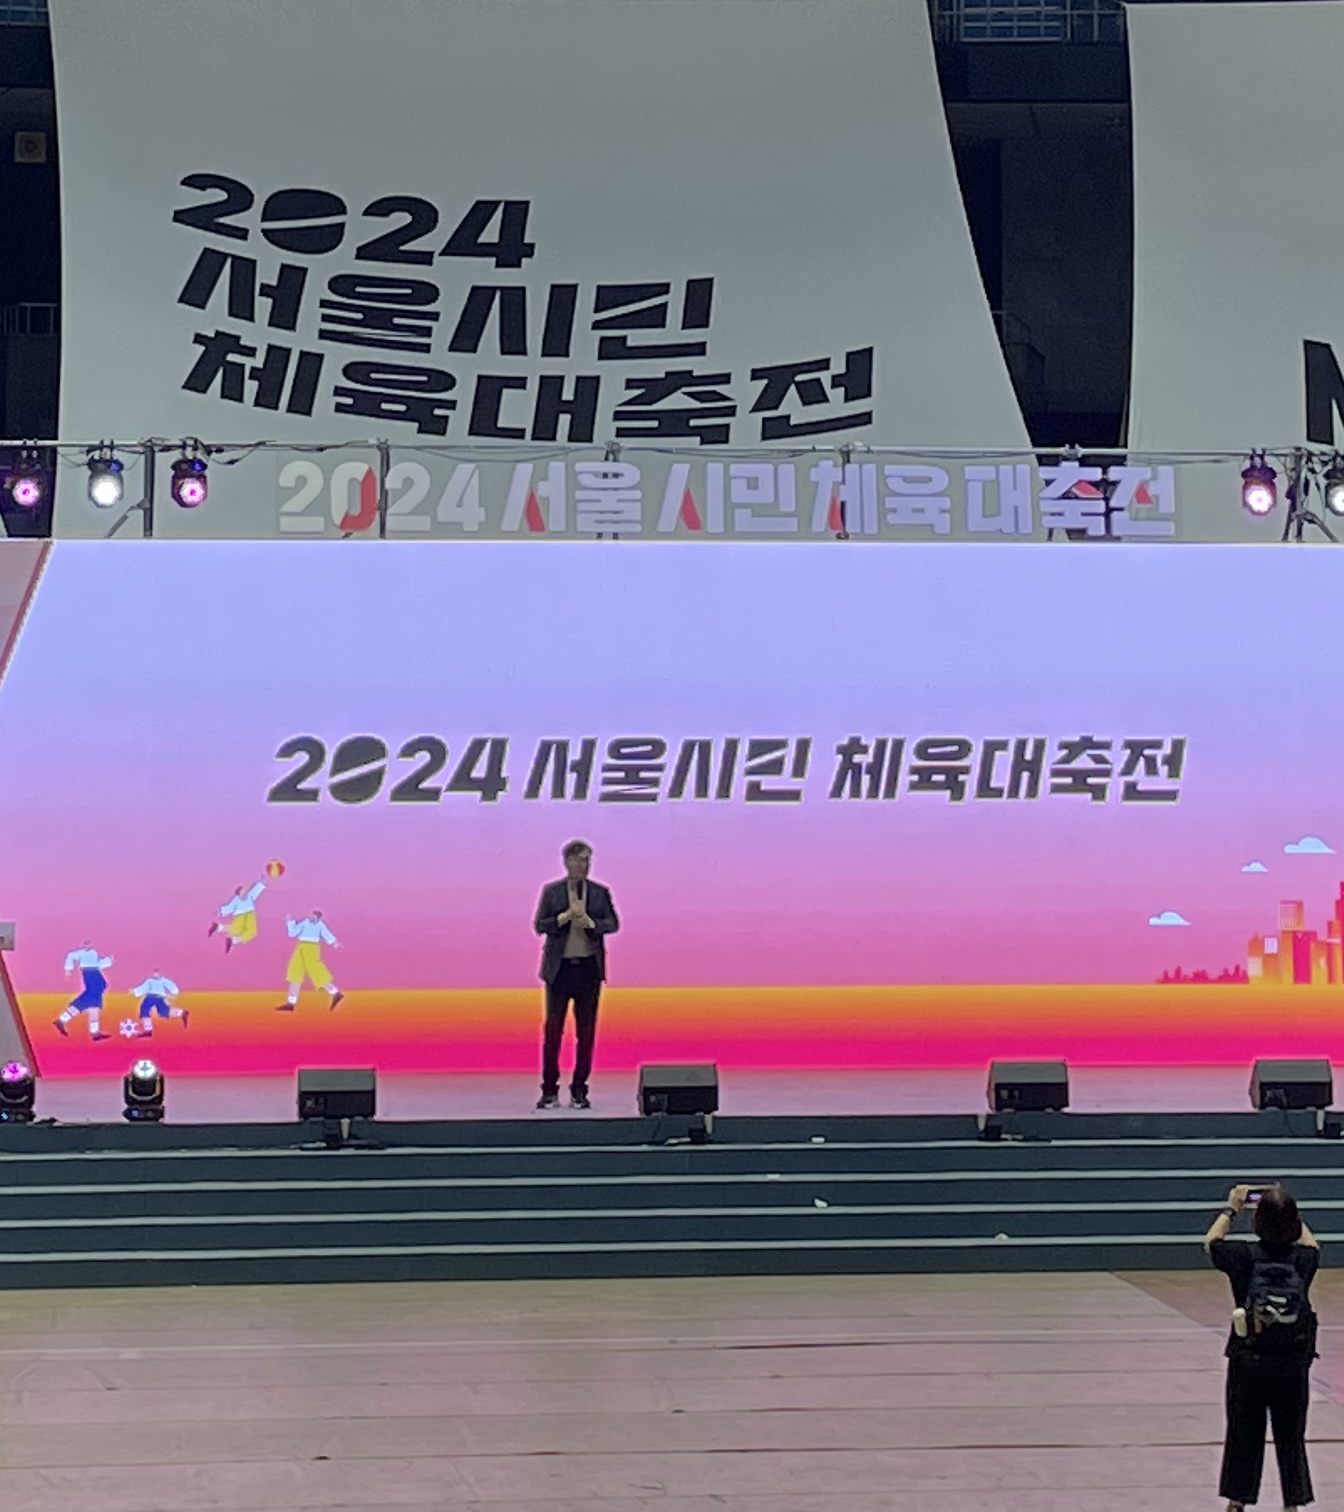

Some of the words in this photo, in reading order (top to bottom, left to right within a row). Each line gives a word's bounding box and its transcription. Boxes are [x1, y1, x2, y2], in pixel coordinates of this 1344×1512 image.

[171, 172, 536, 269] 2024
[176, 246, 716, 361] 서울시민
[180, 329, 875, 446] 체육대축전
[276, 460, 486, 535] 2024
[266, 734, 511, 805] 2024
[523, 734, 813, 805] 서울시민
[827, 734, 1188, 805] 체육대축전
